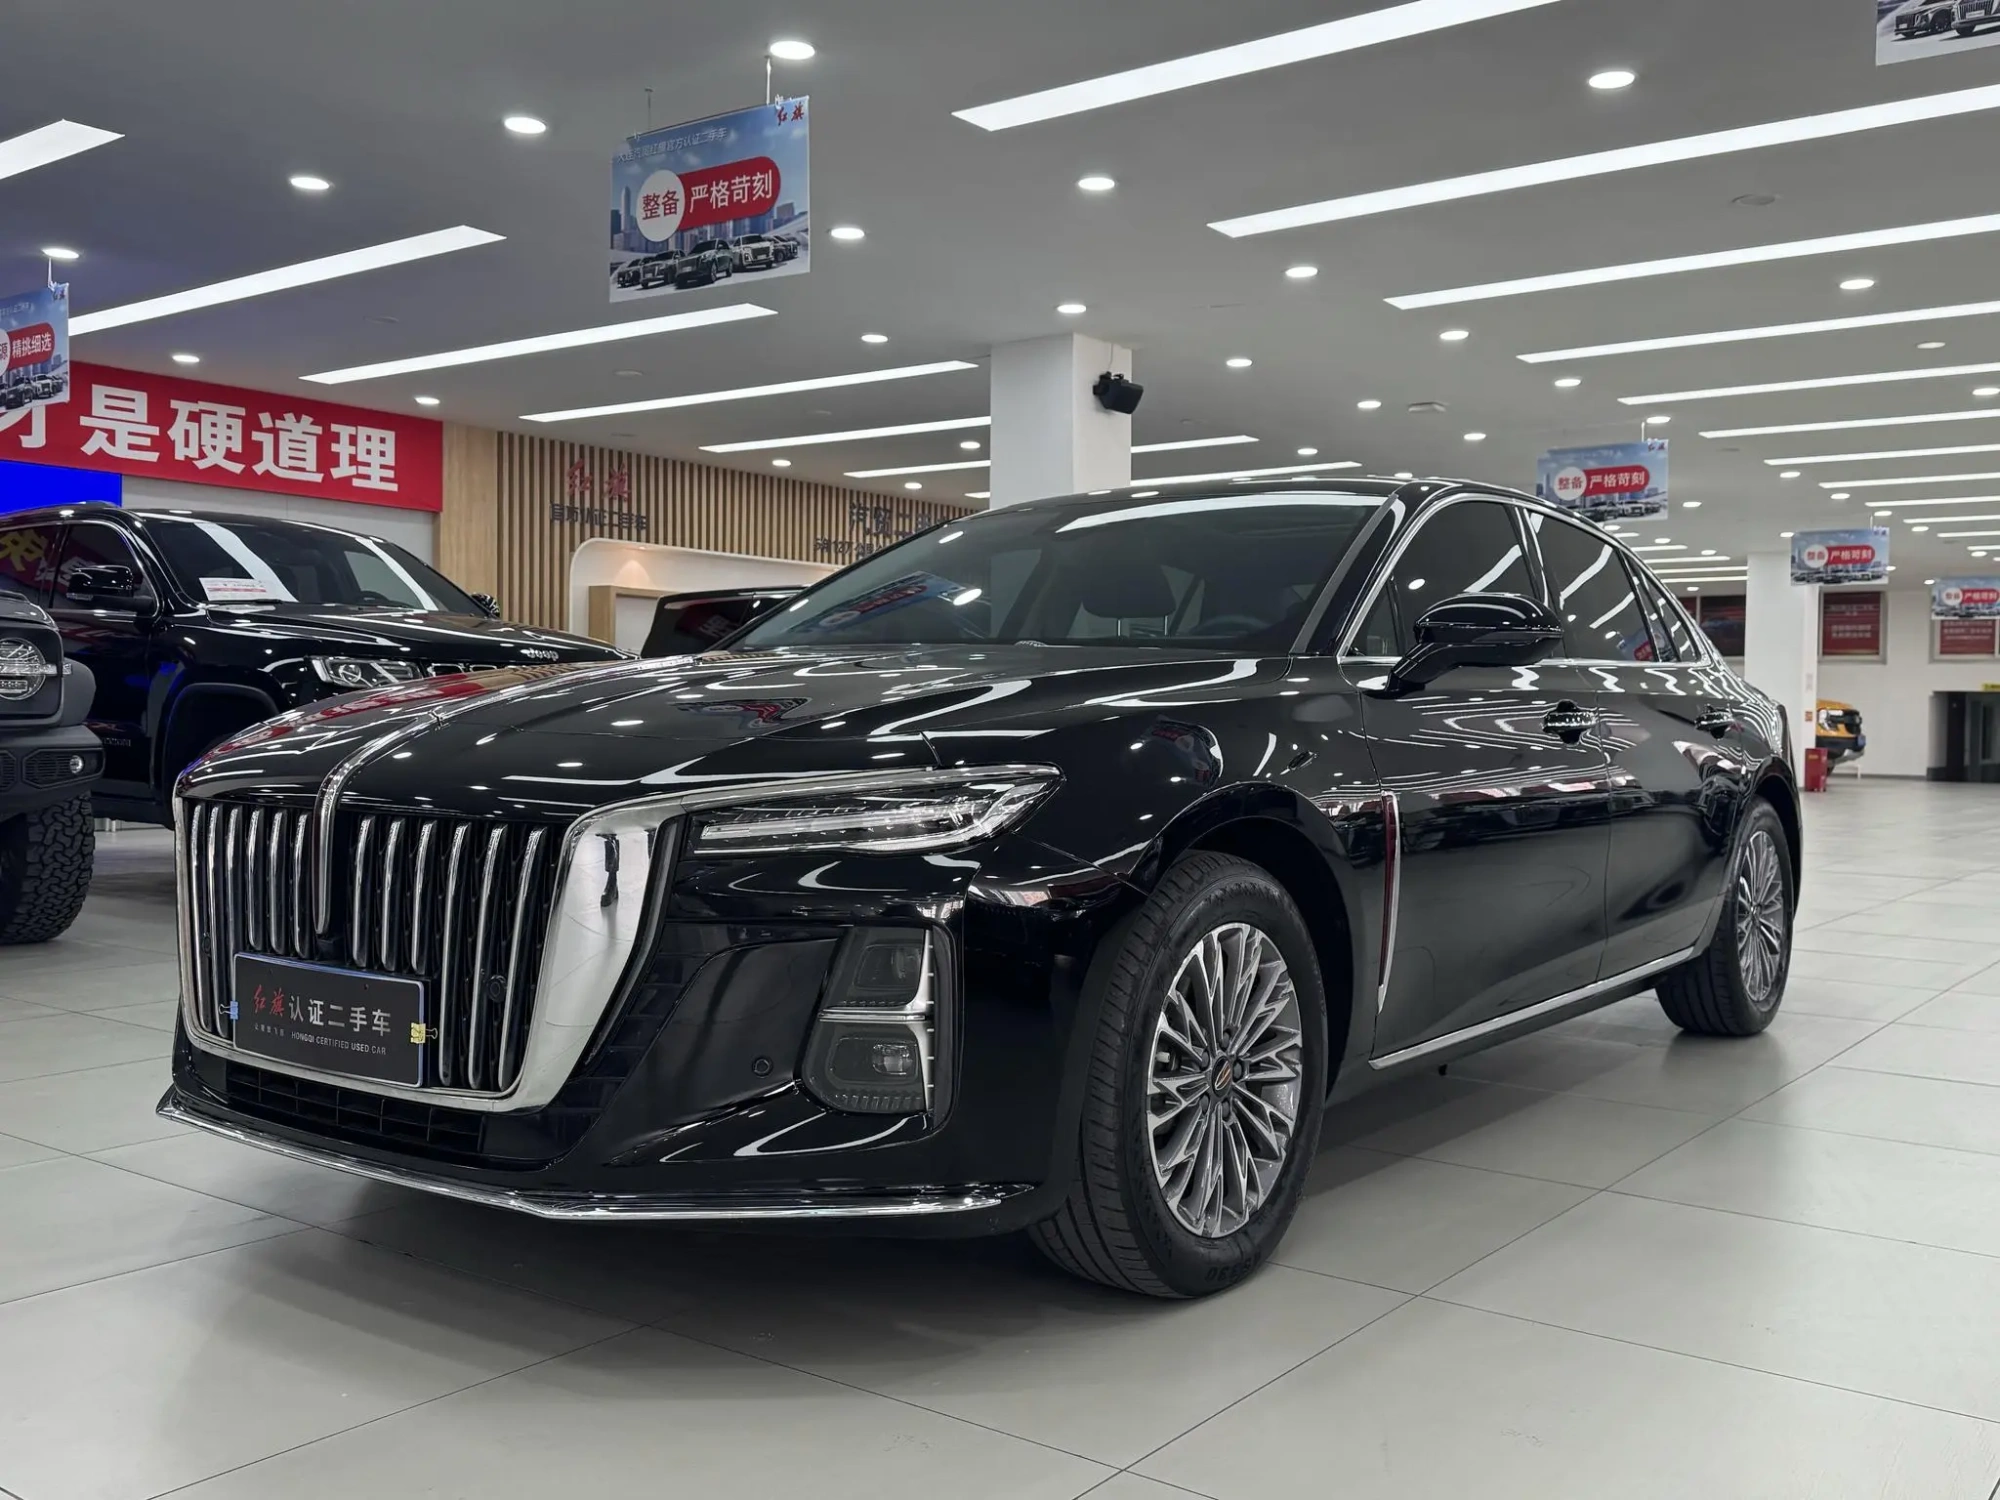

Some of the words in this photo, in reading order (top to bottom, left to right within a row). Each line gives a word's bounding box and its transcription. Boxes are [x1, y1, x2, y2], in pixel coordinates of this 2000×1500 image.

[777, 103, 805, 126] 红旗
[642, 189, 680, 221] 整备
[689, 170, 773, 214] 严格苛刻
[12, 332, 52, 359] 精挑细选
[1558, 476, 1583, 491] 整备
[1590, 471, 1645, 490] 严格苛刻
[291, 1031, 315, 1044] HONGQI
[315, 1036, 350, 1050] CERTIFIED
[350, 1042, 370, 1054] USED
[371, 1045, 387, 1056] CAR
